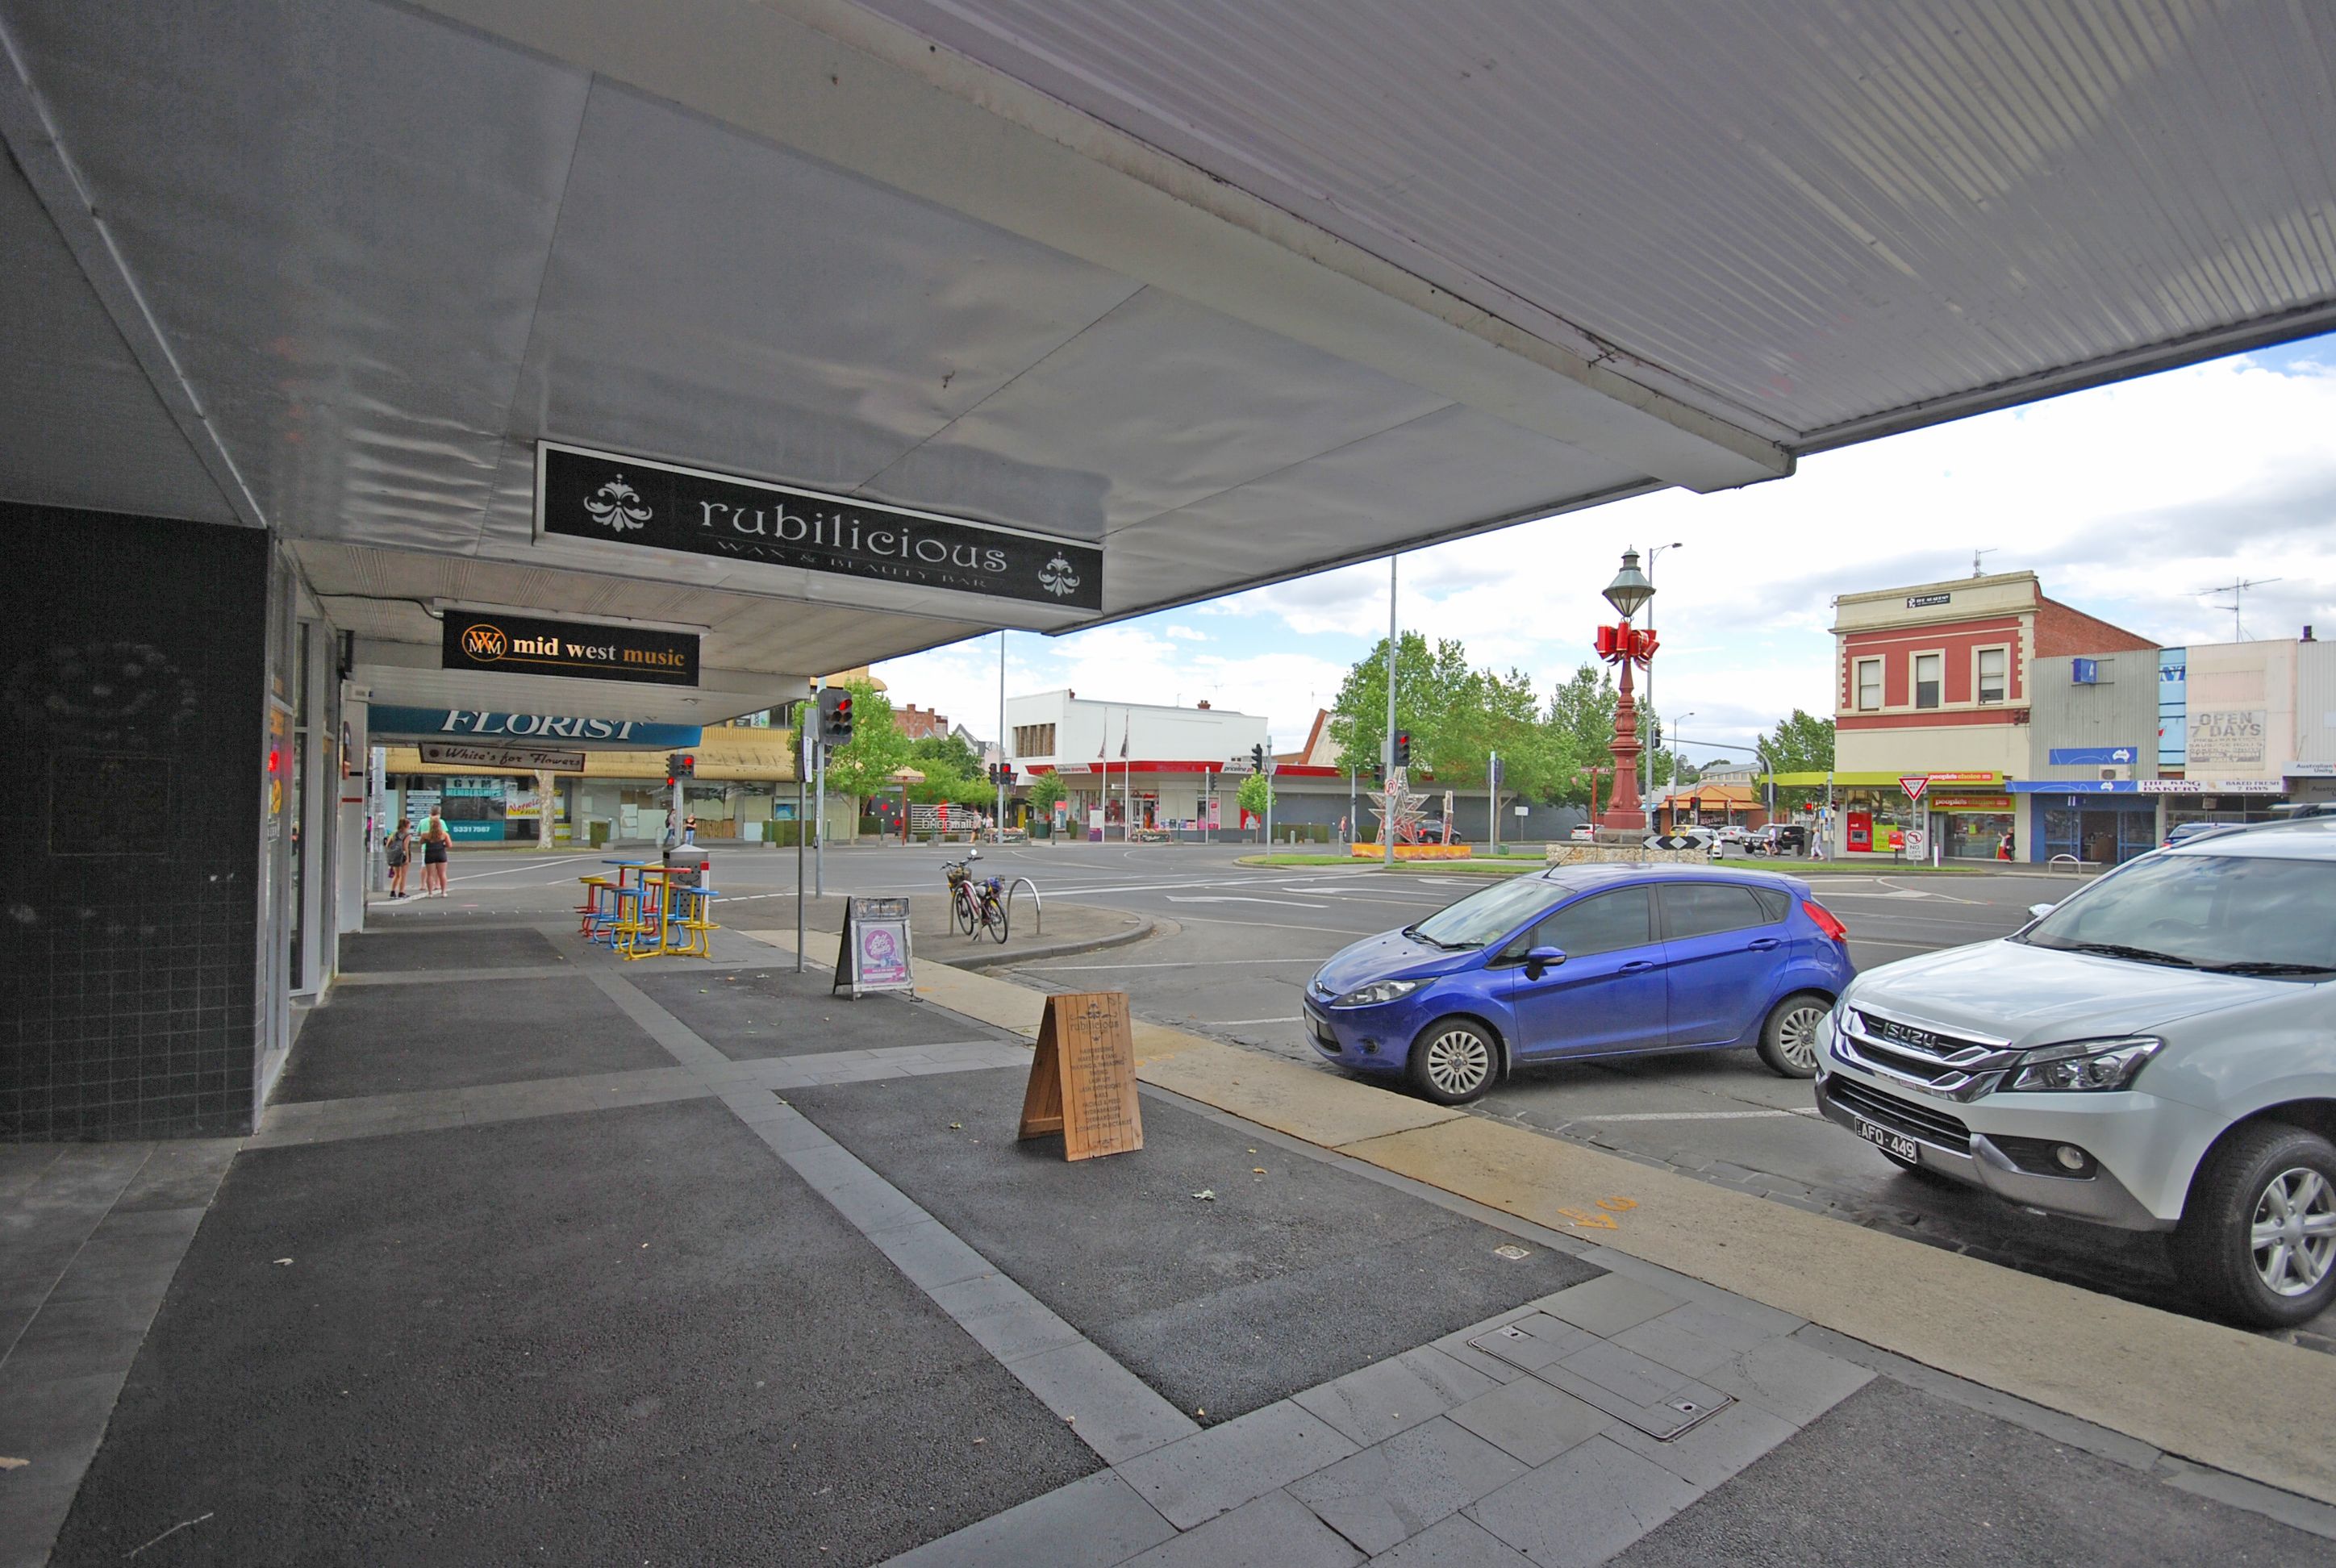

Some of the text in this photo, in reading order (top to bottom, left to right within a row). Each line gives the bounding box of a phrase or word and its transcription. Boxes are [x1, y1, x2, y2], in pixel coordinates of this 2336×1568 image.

[699, 501, 1007, 572] rubilicious
[717, 540, 786, 559] WAX
[831, 558, 928, 579] BEAUTY
[942, 574, 987, 587] BAR
[513, 636, 685, 666] mid west music
[440, 710, 644, 740] FLORIST
[2189, 724, 2261, 737] 7 DAYS
[2200, 713, 2252, 725] OPEN
[444, 748, 582, 765] White's for Flowers
[1070, 1020, 1120, 1032] rubilicious
[1883, 1022, 1937, 1049] ISUZU
